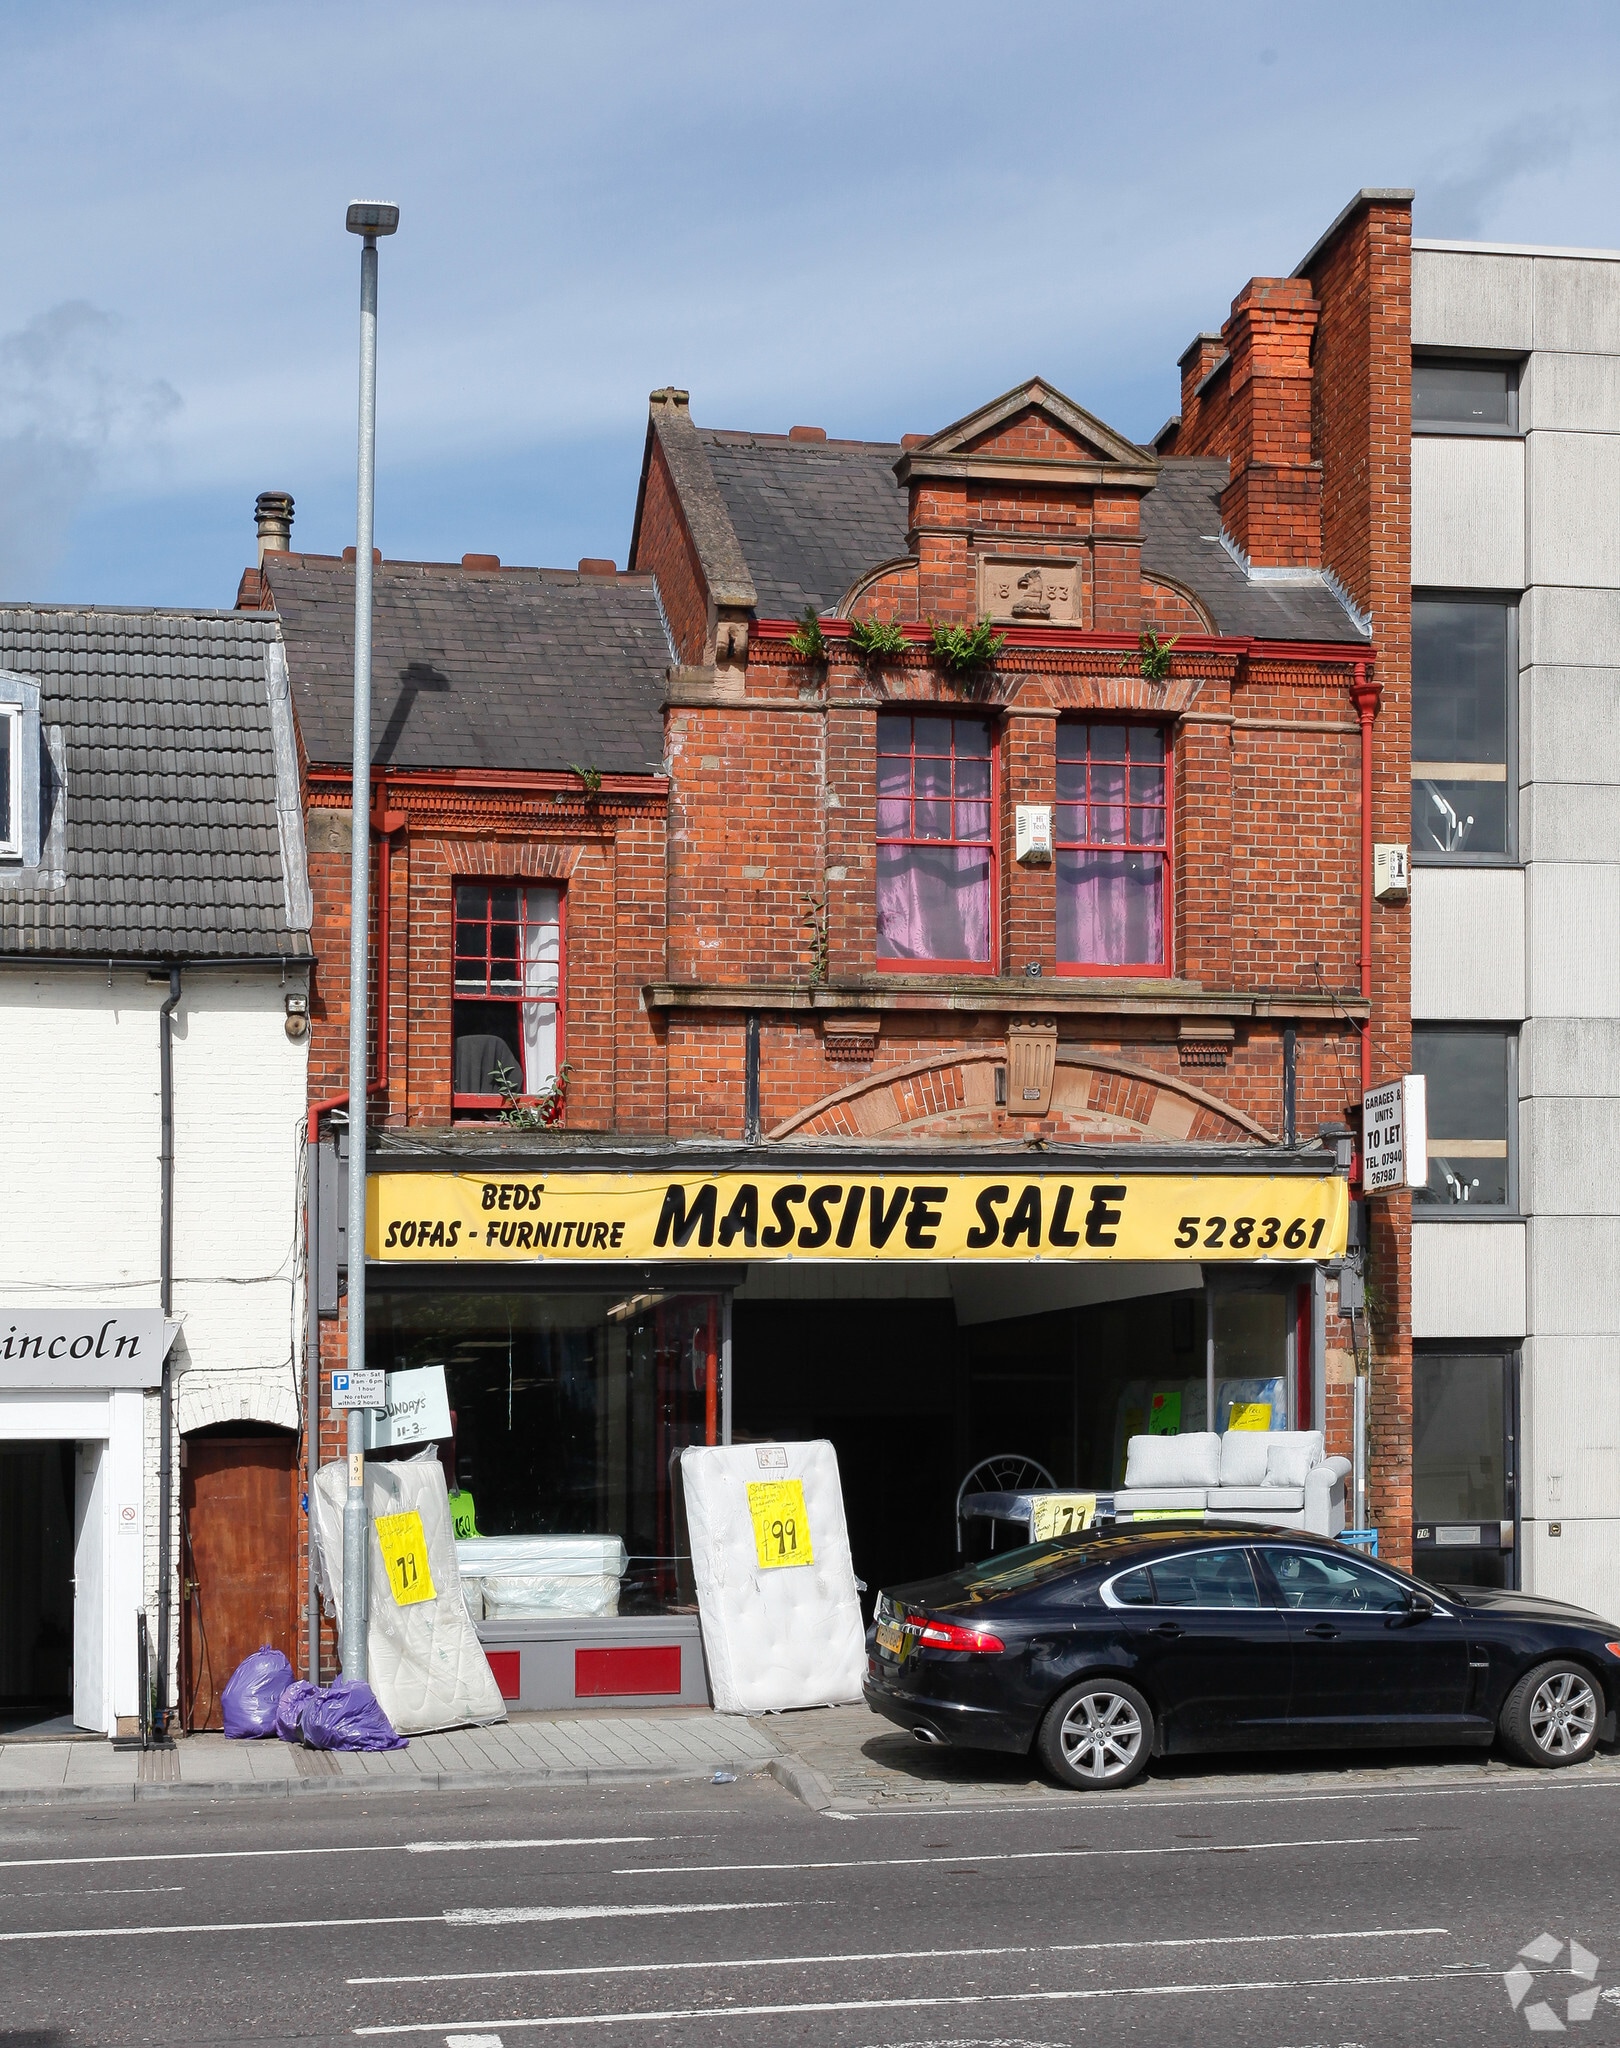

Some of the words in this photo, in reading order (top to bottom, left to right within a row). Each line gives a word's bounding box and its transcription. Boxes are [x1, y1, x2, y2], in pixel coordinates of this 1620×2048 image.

[1365, 1091, 1394, 1110] GARAGES
[1396, 1088, 1402, 1100] &
[1374, 1107, 1394, 1123] UNITS
[1367, 1130, 1380, 1150] TO
[1384, 1124, 1401, 1146] LET
[1365, 1156, 1379, 1170] TEL.
[1381, 1149, 1403, 1167] 07940
[1371, 1167, 1397, 1185] 267987
[481, 1183, 545, 1211] BEDS
[652, 1184, 948, 1249] MASSIVE
[966, 1185, 1128, 1249] SALE
[384, 1220, 462, 1248] SOFAS
[485, 1221, 626, 1250] FURNITURE
[1173, 1216, 1326, 1249] 528361
[0, 1319, 142, 1360] incoln
[375, 1398, 426, 1422] SUNDAYS
